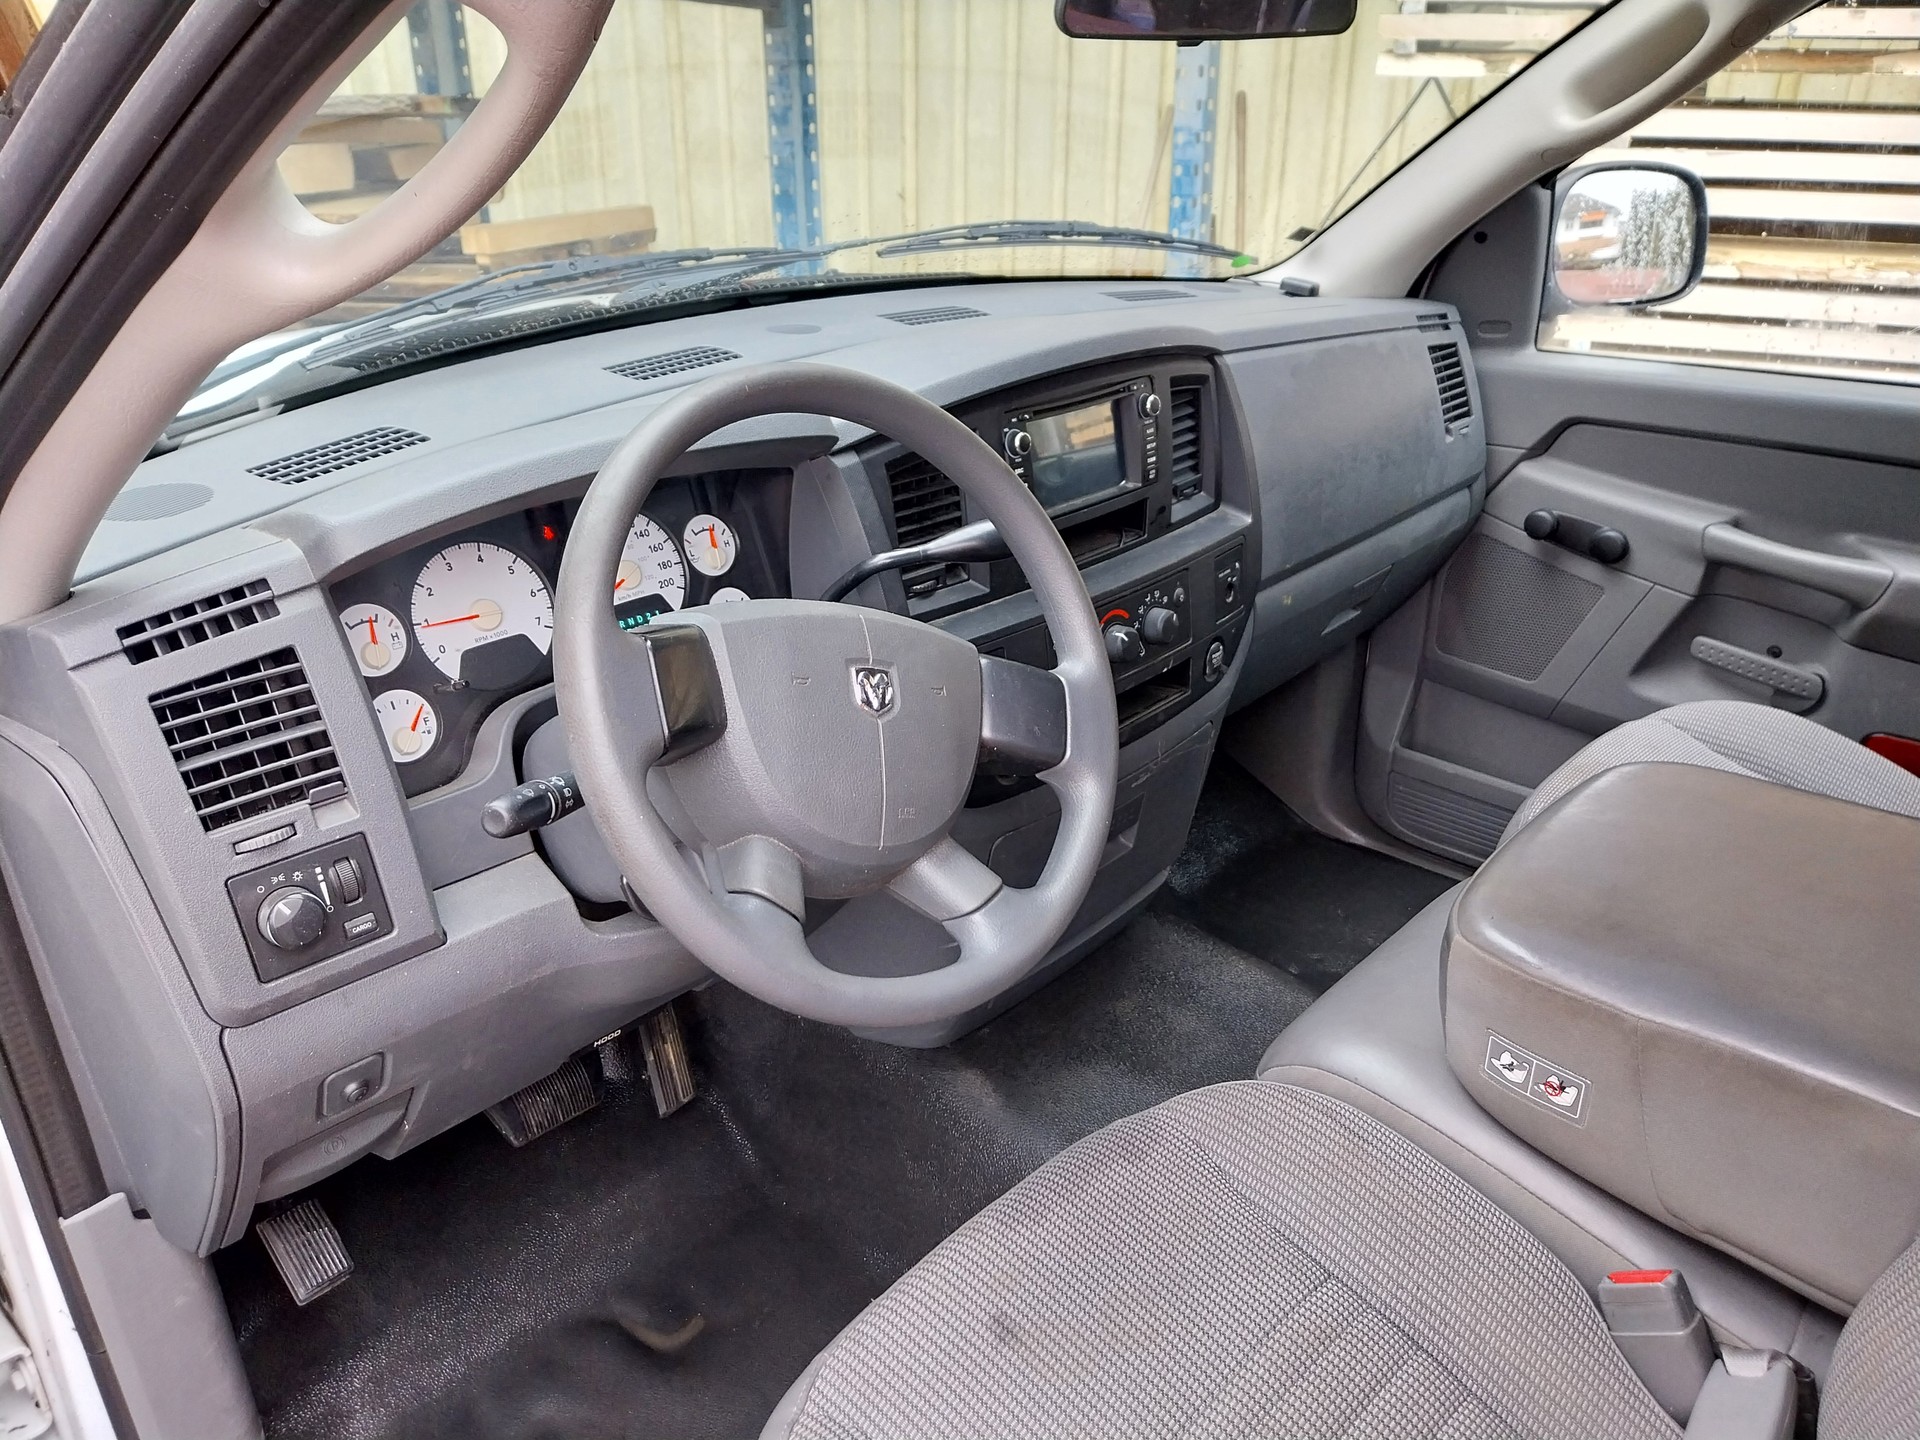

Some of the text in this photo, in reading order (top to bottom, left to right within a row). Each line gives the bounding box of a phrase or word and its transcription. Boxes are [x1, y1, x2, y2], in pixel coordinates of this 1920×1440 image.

[634, 528, 650, 540] 140
[648, 542, 664, 554] 160
[723, 540, 731, 548] H
[689, 549, 695, 557] L
[477, 554, 484, 564] 4
[445, 562, 453, 572] 3
[657, 559, 673, 571] 180
[507, 566, 515, 575] 5
[658, 577, 675, 589] 200
[426, 587, 434, 597] 2
[530, 588, 537, 598] 6
[424, 618, 431, 626] 1
[535, 616, 541, 626] 7
[619, 620, 625, 628] R
[628, 617, 635, 625] N
[637, 615, 643, 623] D
[646, 612, 651, 620] 2
[391, 632, 400, 642] H
[474, 634, 489, 643] RPM
[494, 629, 508, 638] 1000
[438, 644, 446, 654] 0
[423, 716, 429, 726] F
[352, 921, 372, 934] CARGO
[593, 1029, 622, 1048] HOOD
